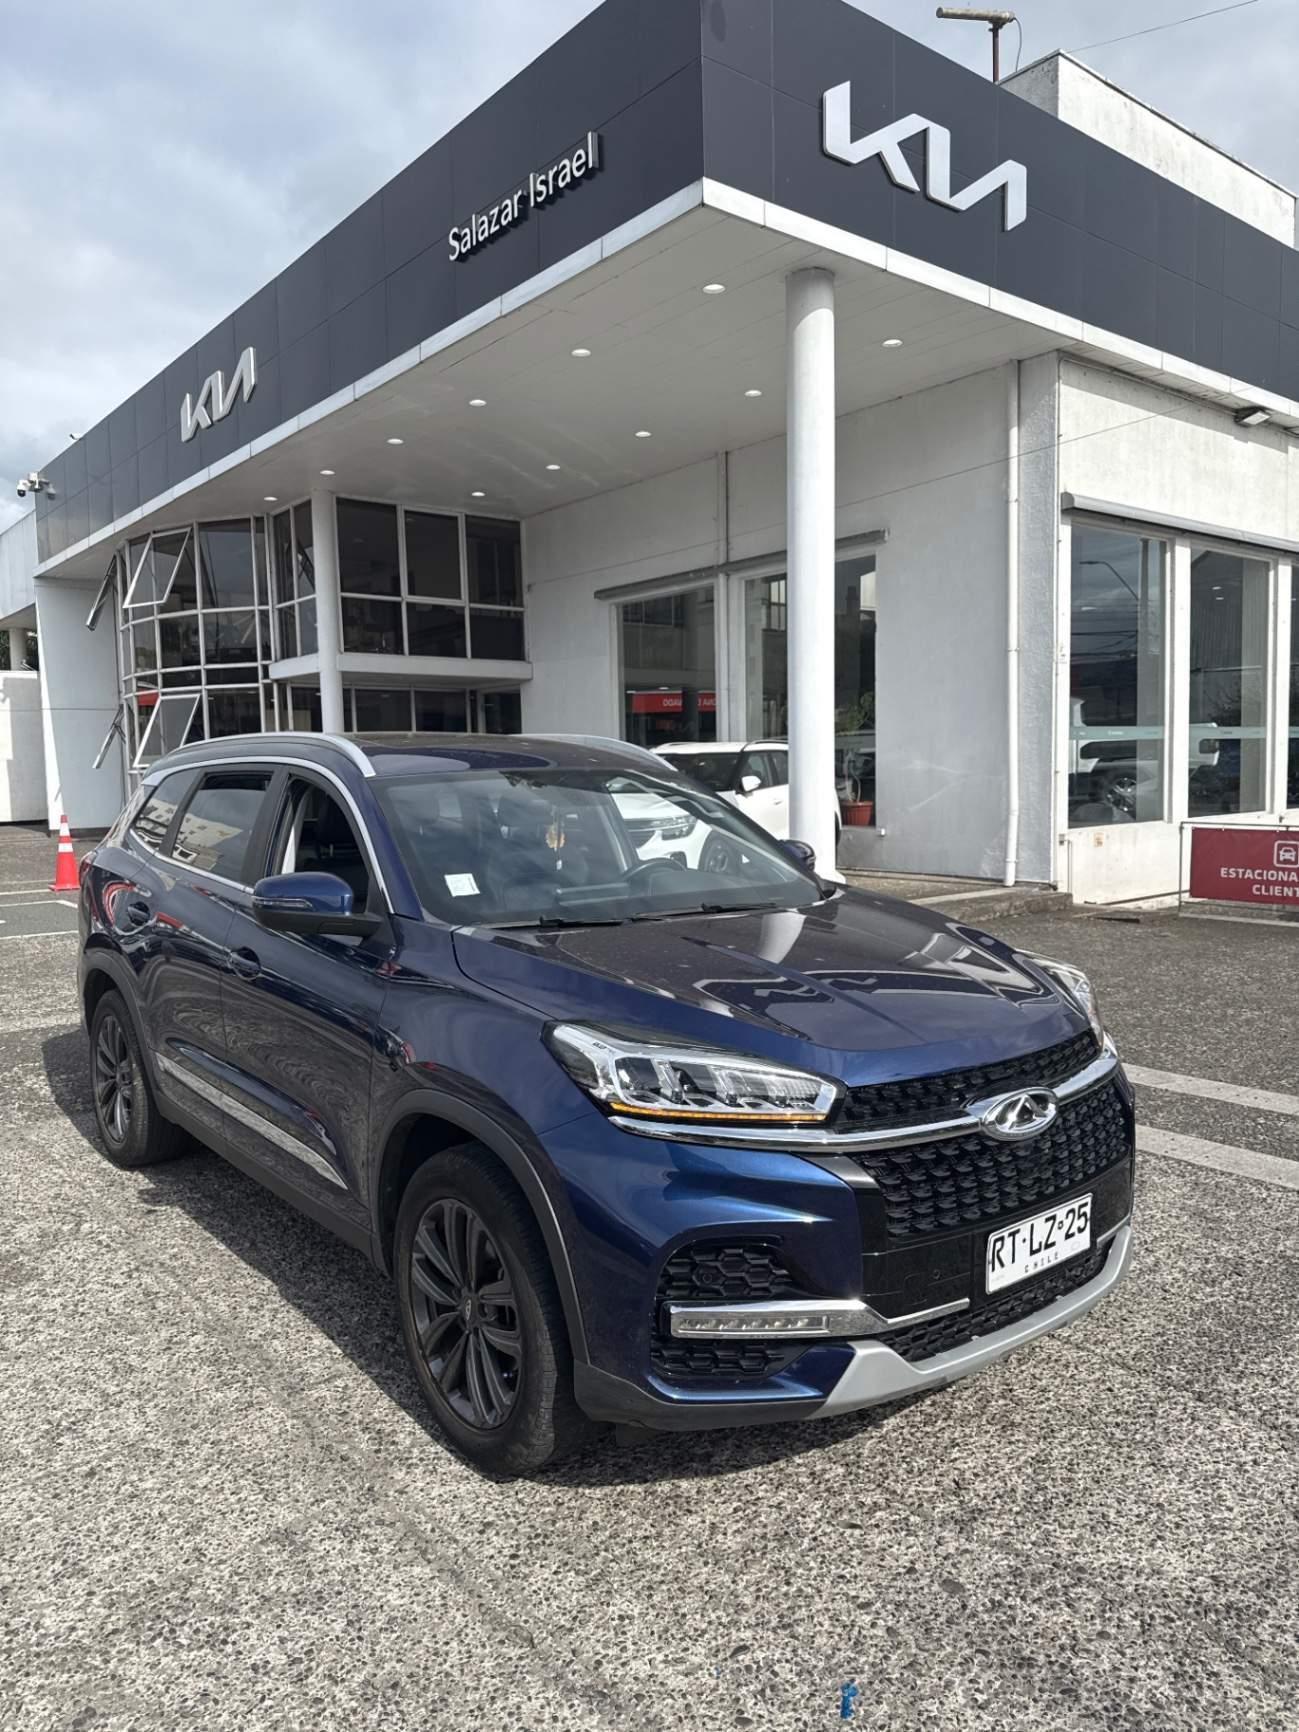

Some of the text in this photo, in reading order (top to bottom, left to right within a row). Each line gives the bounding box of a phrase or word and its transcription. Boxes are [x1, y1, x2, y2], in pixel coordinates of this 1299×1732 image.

[449, 131, 598, 261] Salazar Israel
[823, 80, 1027, 231] KIA
[181, 347, 255, 442] KIA
